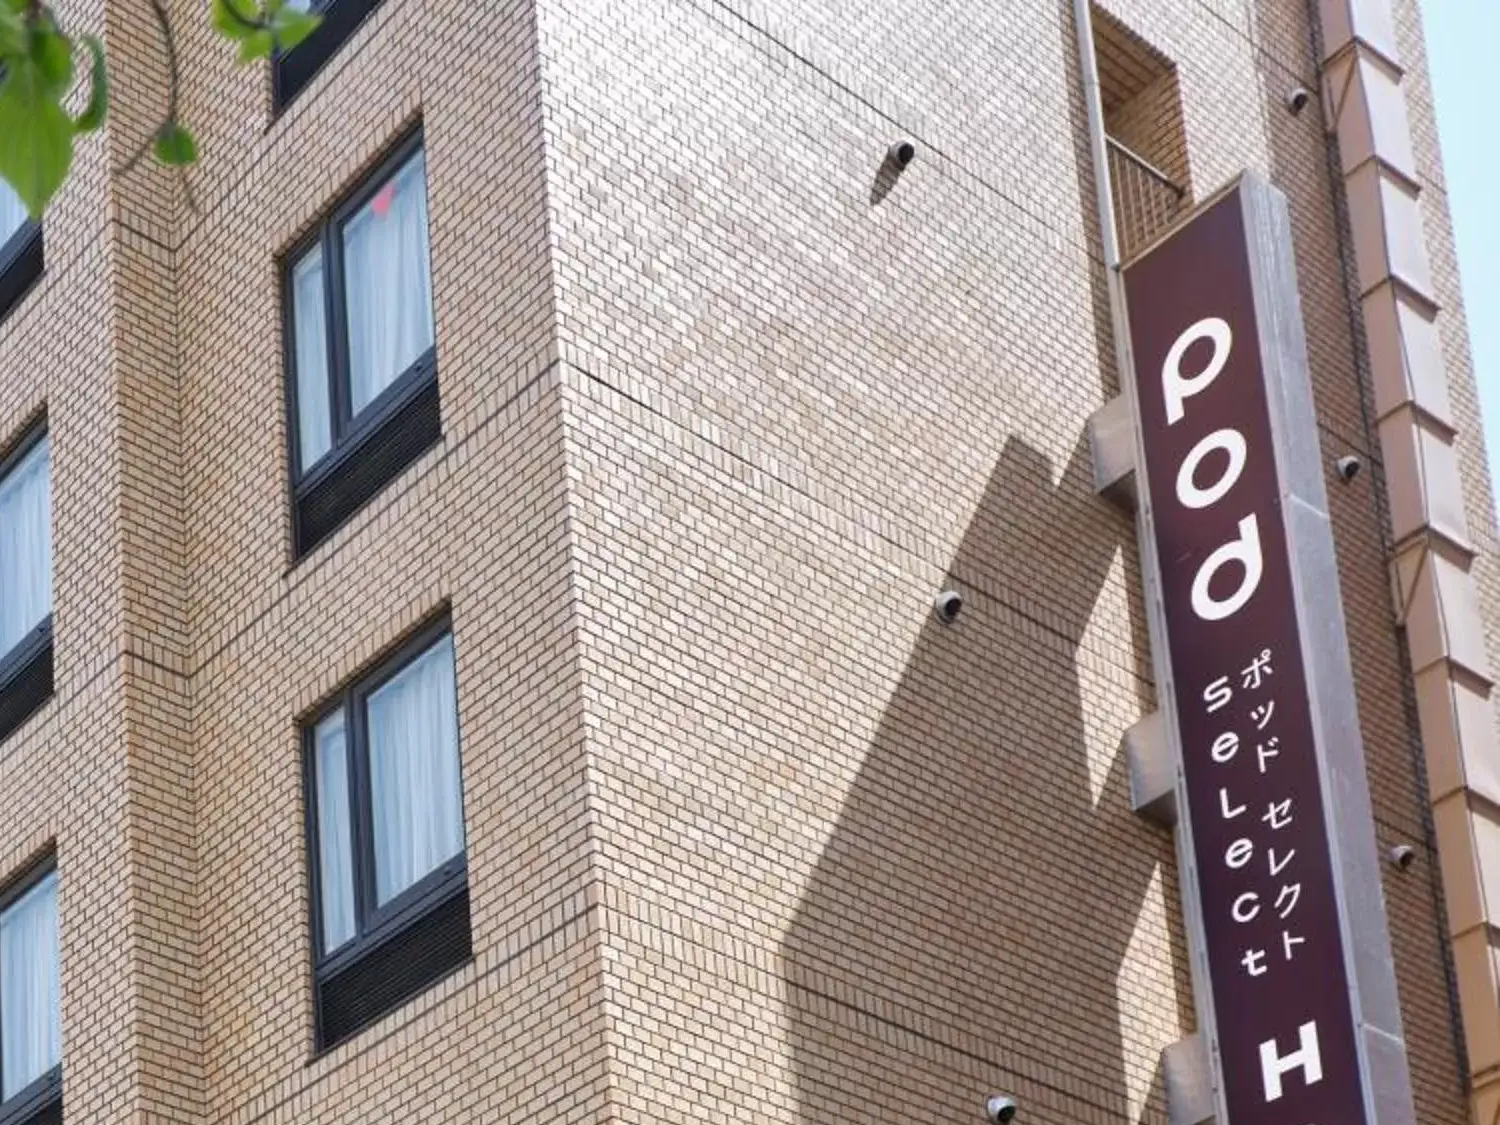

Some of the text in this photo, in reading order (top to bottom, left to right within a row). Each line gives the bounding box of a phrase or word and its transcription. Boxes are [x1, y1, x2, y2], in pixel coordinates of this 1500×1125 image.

[1242, 649, 1306, 960] ポッド セレクト
